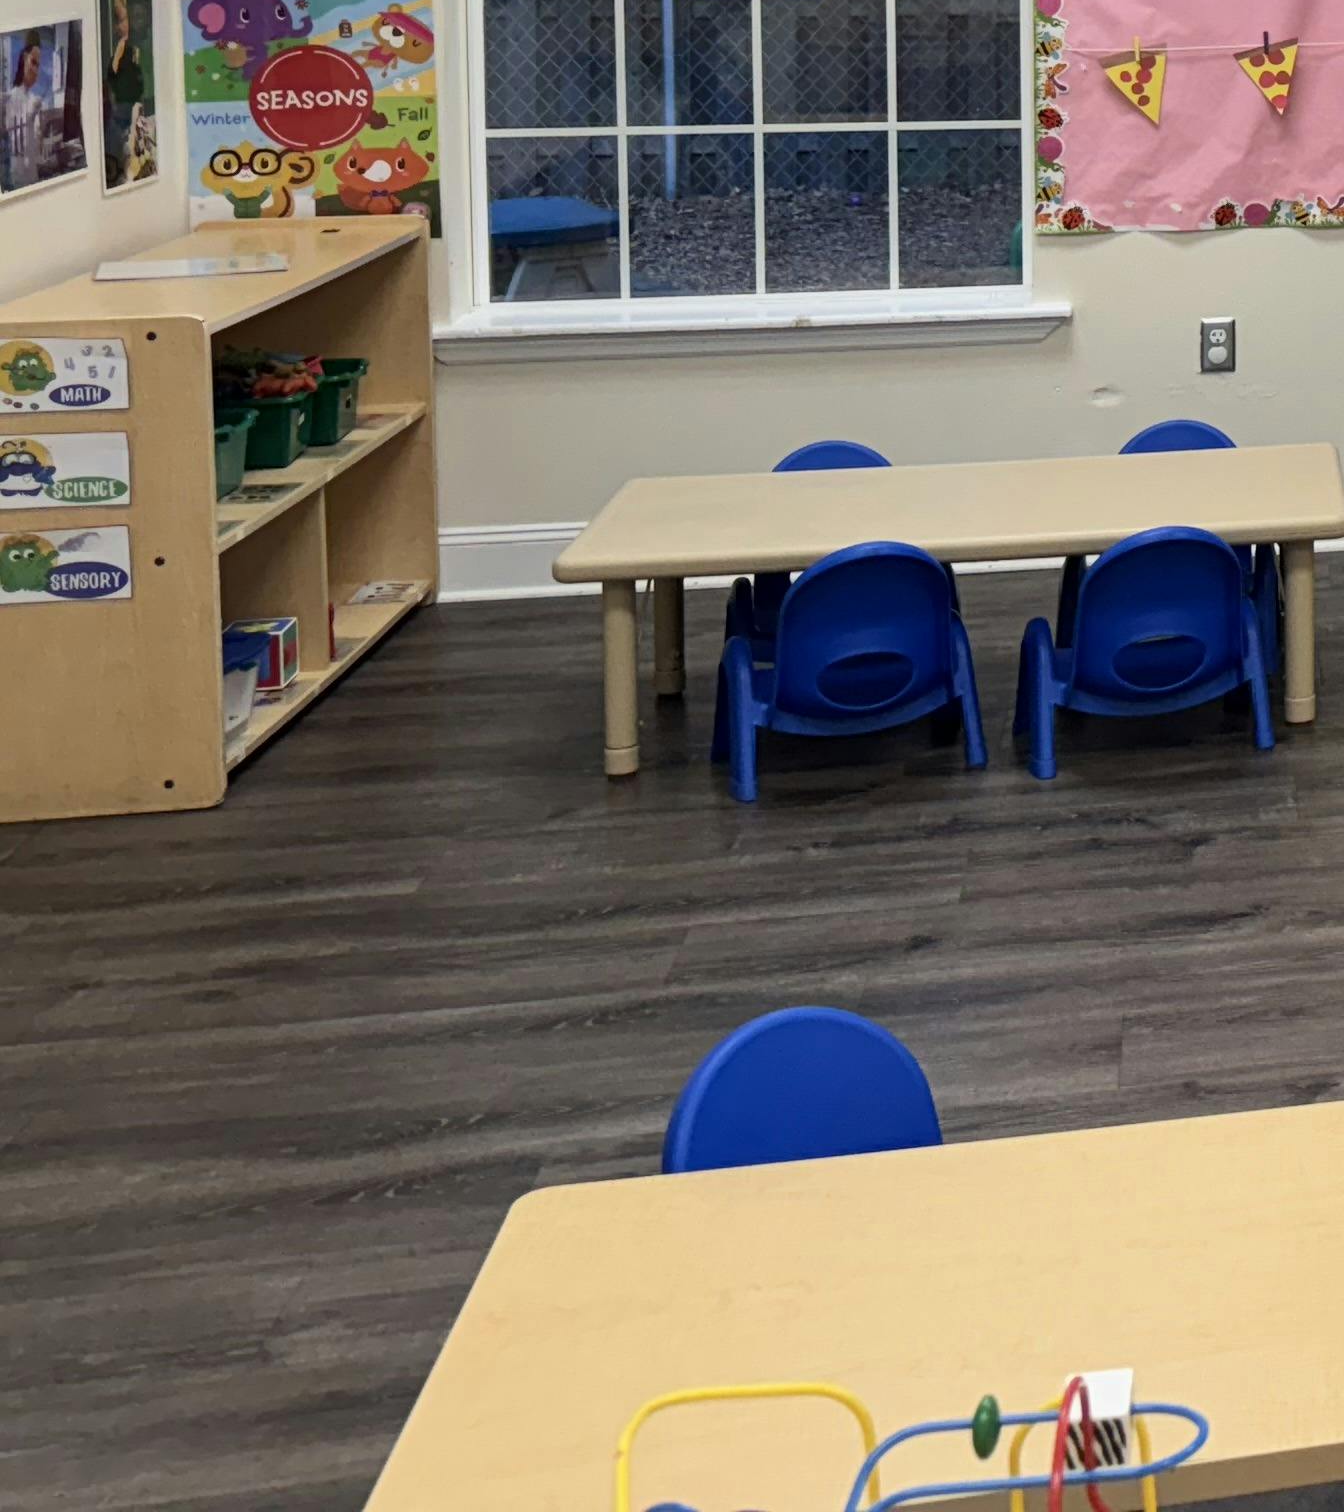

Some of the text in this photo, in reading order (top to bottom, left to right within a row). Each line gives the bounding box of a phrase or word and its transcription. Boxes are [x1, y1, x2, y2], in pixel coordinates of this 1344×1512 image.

[256, 89, 369, 111] SEASONS
[191, 106, 429, 126] Winter Fall
[102, 345, 116, 358] 2
[88, 365, 98, 379] 5
[60, 386, 102, 403] MATH
[52, 481, 118, 499] SCIENCE
[50, 572, 122, 592] SENSORY
